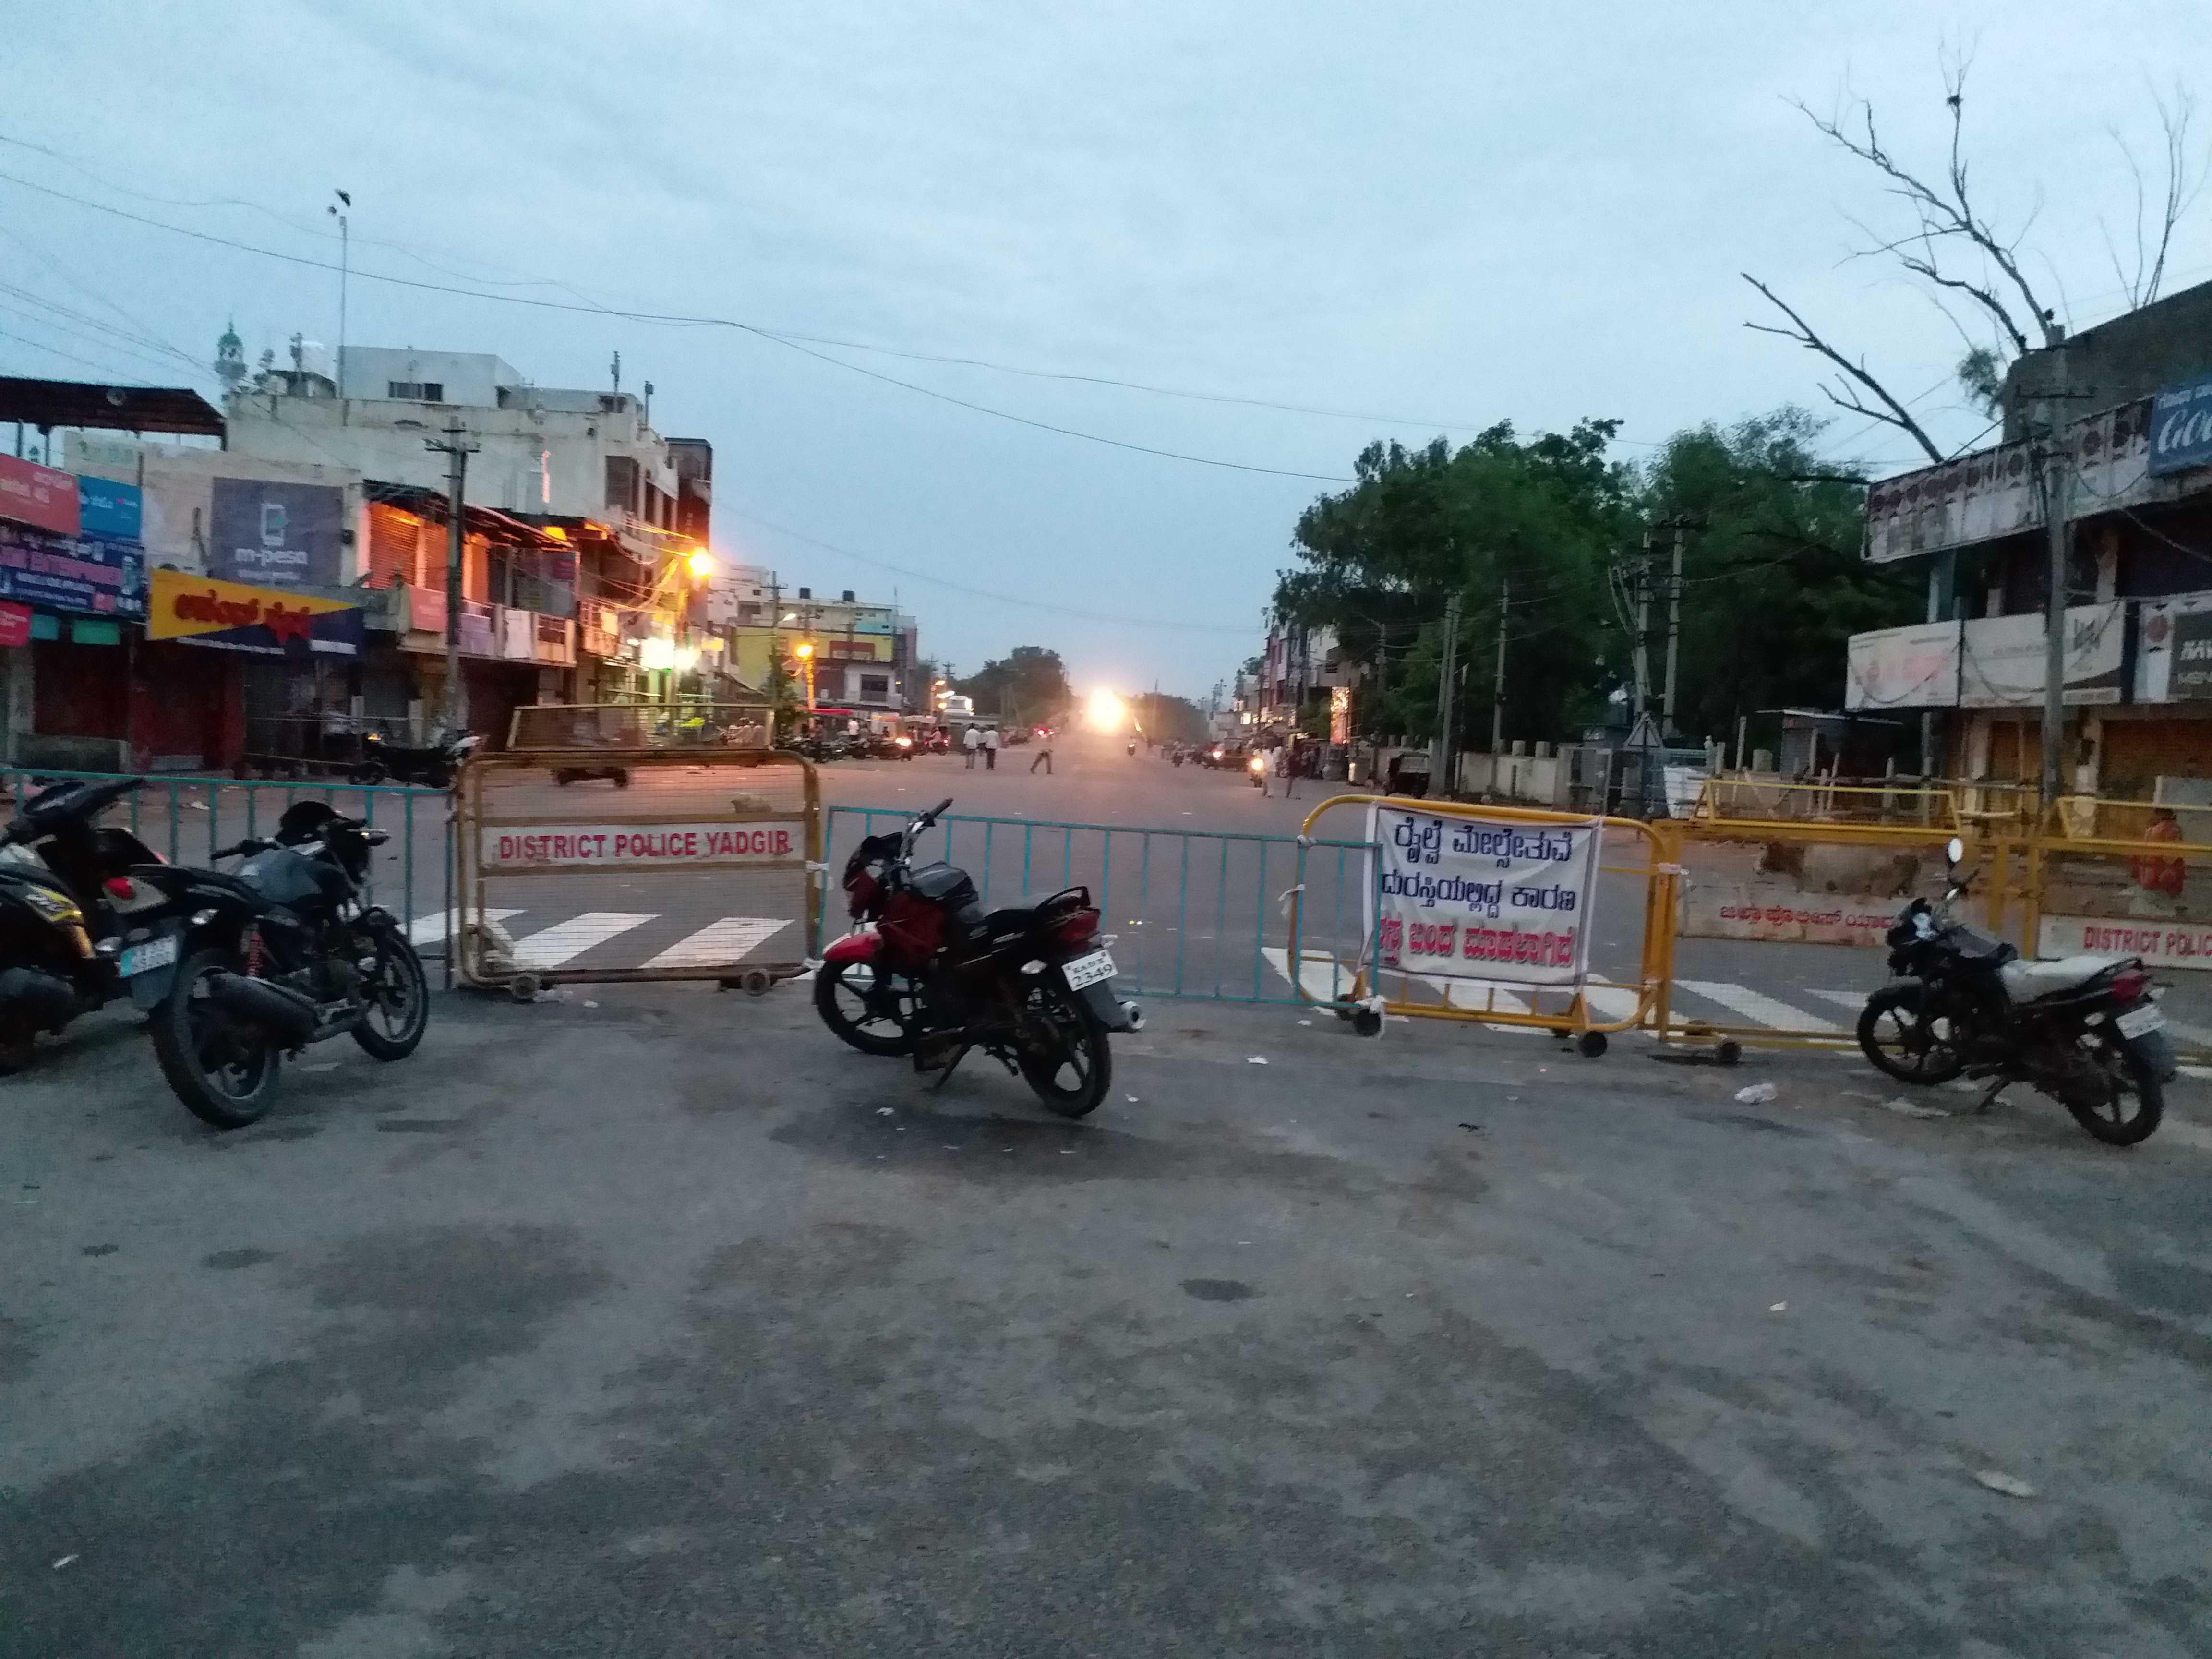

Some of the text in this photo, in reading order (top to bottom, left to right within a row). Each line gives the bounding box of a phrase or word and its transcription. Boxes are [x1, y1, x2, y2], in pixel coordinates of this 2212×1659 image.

[500, 830, 790, 859] DISTRICT POLICE YADGIR
[1395, 817, 1573, 868] ರೈಲ್ವೆ ಮೇಲ್ಸೇತುವೆ
[1511, 884, 1576, 911] ಕಾರಣ
[2084, 927, 2161, 952] DISTRICT
[1072, 963, 1113, 987] 2349
